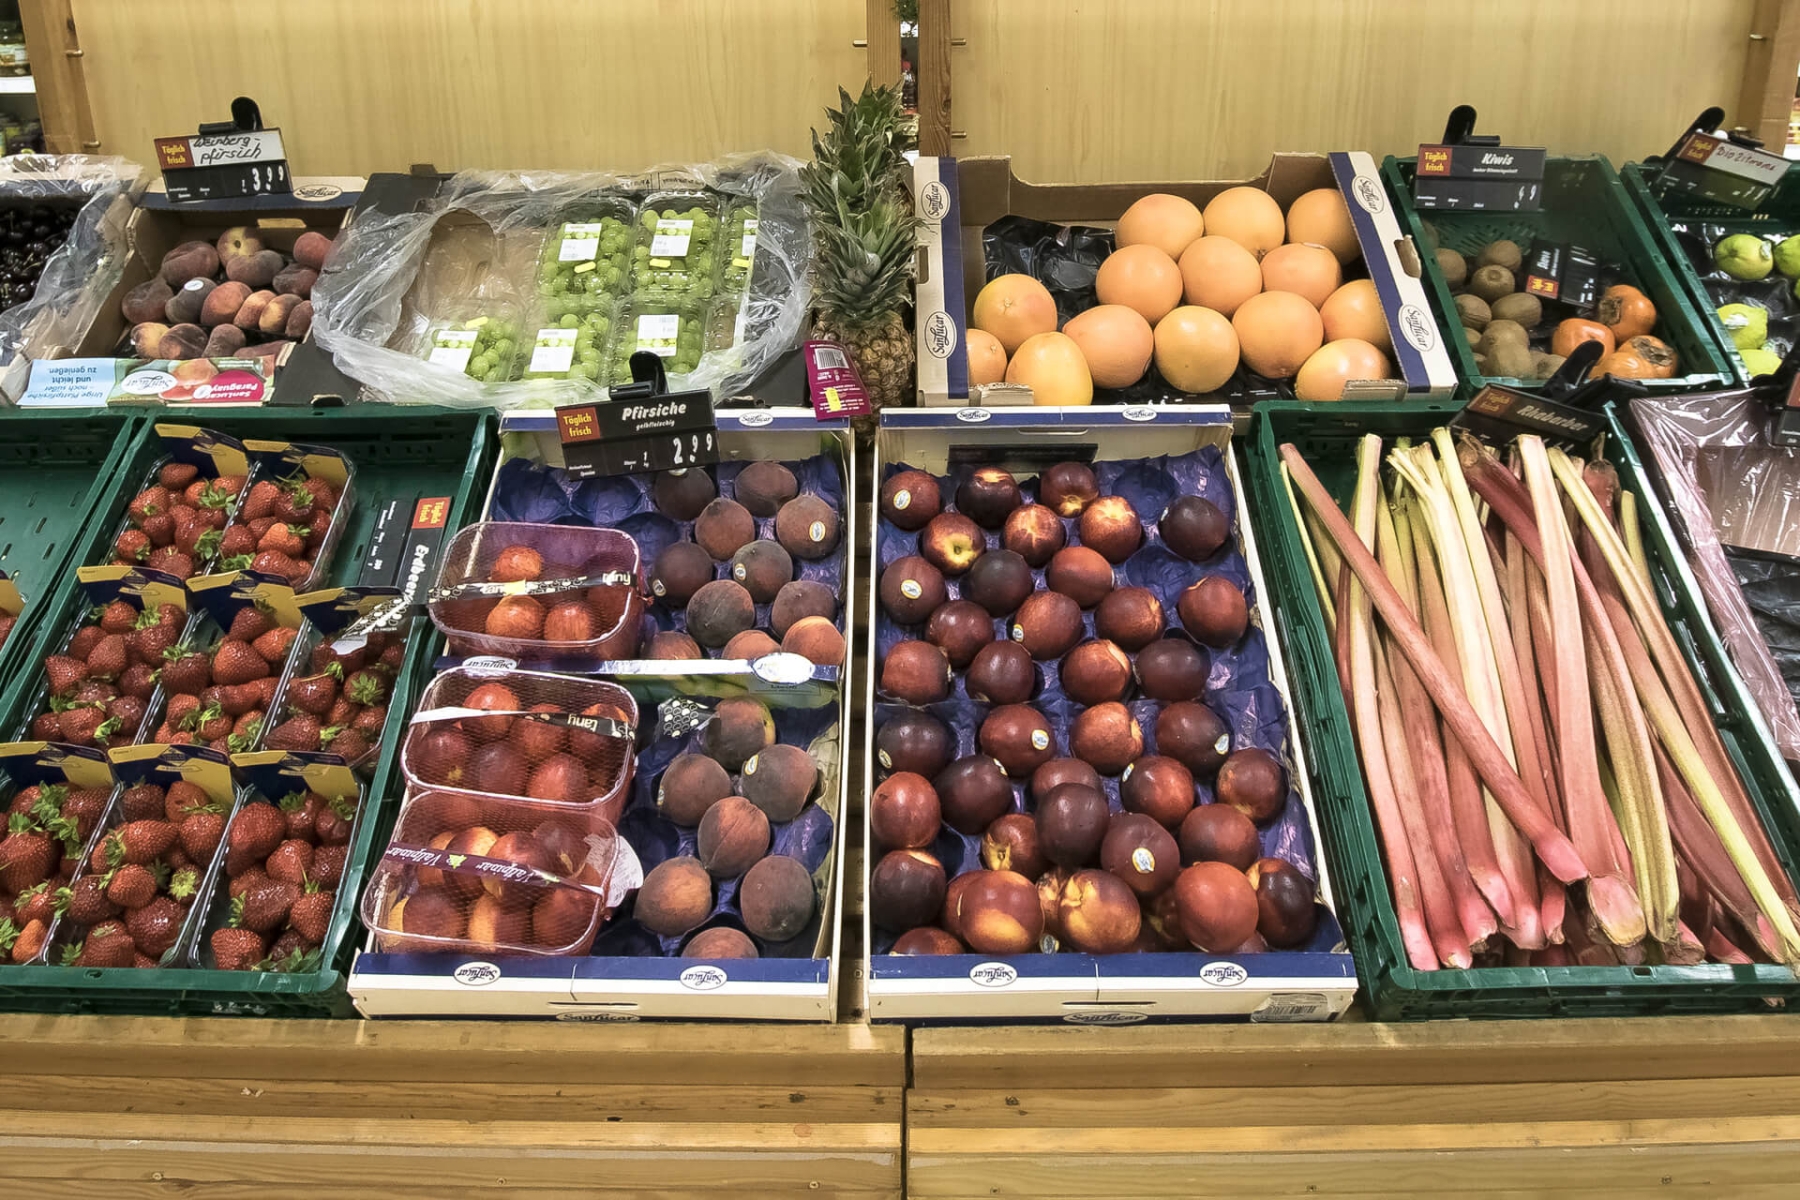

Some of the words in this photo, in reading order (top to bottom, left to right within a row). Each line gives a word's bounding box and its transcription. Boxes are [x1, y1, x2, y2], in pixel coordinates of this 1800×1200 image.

[162, 145, 186, 155] Täglich
[1424, 152, 1448, 162] Täglich
[167, 156, 186, 164] frisch
[1481, 152, 1515, 166] Kiwis
[926, 184, 944, 217] SanLucar
[1358, 178, 1378, 211] SanLucar
[930, 314, 950, 354] SanLucar
[1406, 308, 1430, 349] SanLucar
[126, 375, 172, 390] SanLucar
[211, 382, 258, 392] Paraguay
[622, 402, 687, 421] Pfirsiche
[959, 408, 989, 420] SanLucar
[1125, 408, 1156, 420] SanLucar
[1516, 405, 1589, 432] Rhabarber
[562, 413, 592, 426] Täglich
[569, 426, 592, 437] frisch
[457, 966, 498, 983] SanLucar
[684, 970, 724, 986] SanLucar
[973, 966, 1014, 984] SanLucar
[1203, 966, 1244, 983] SanLucar
[563, 1012, 636, 1022] SanLucar
